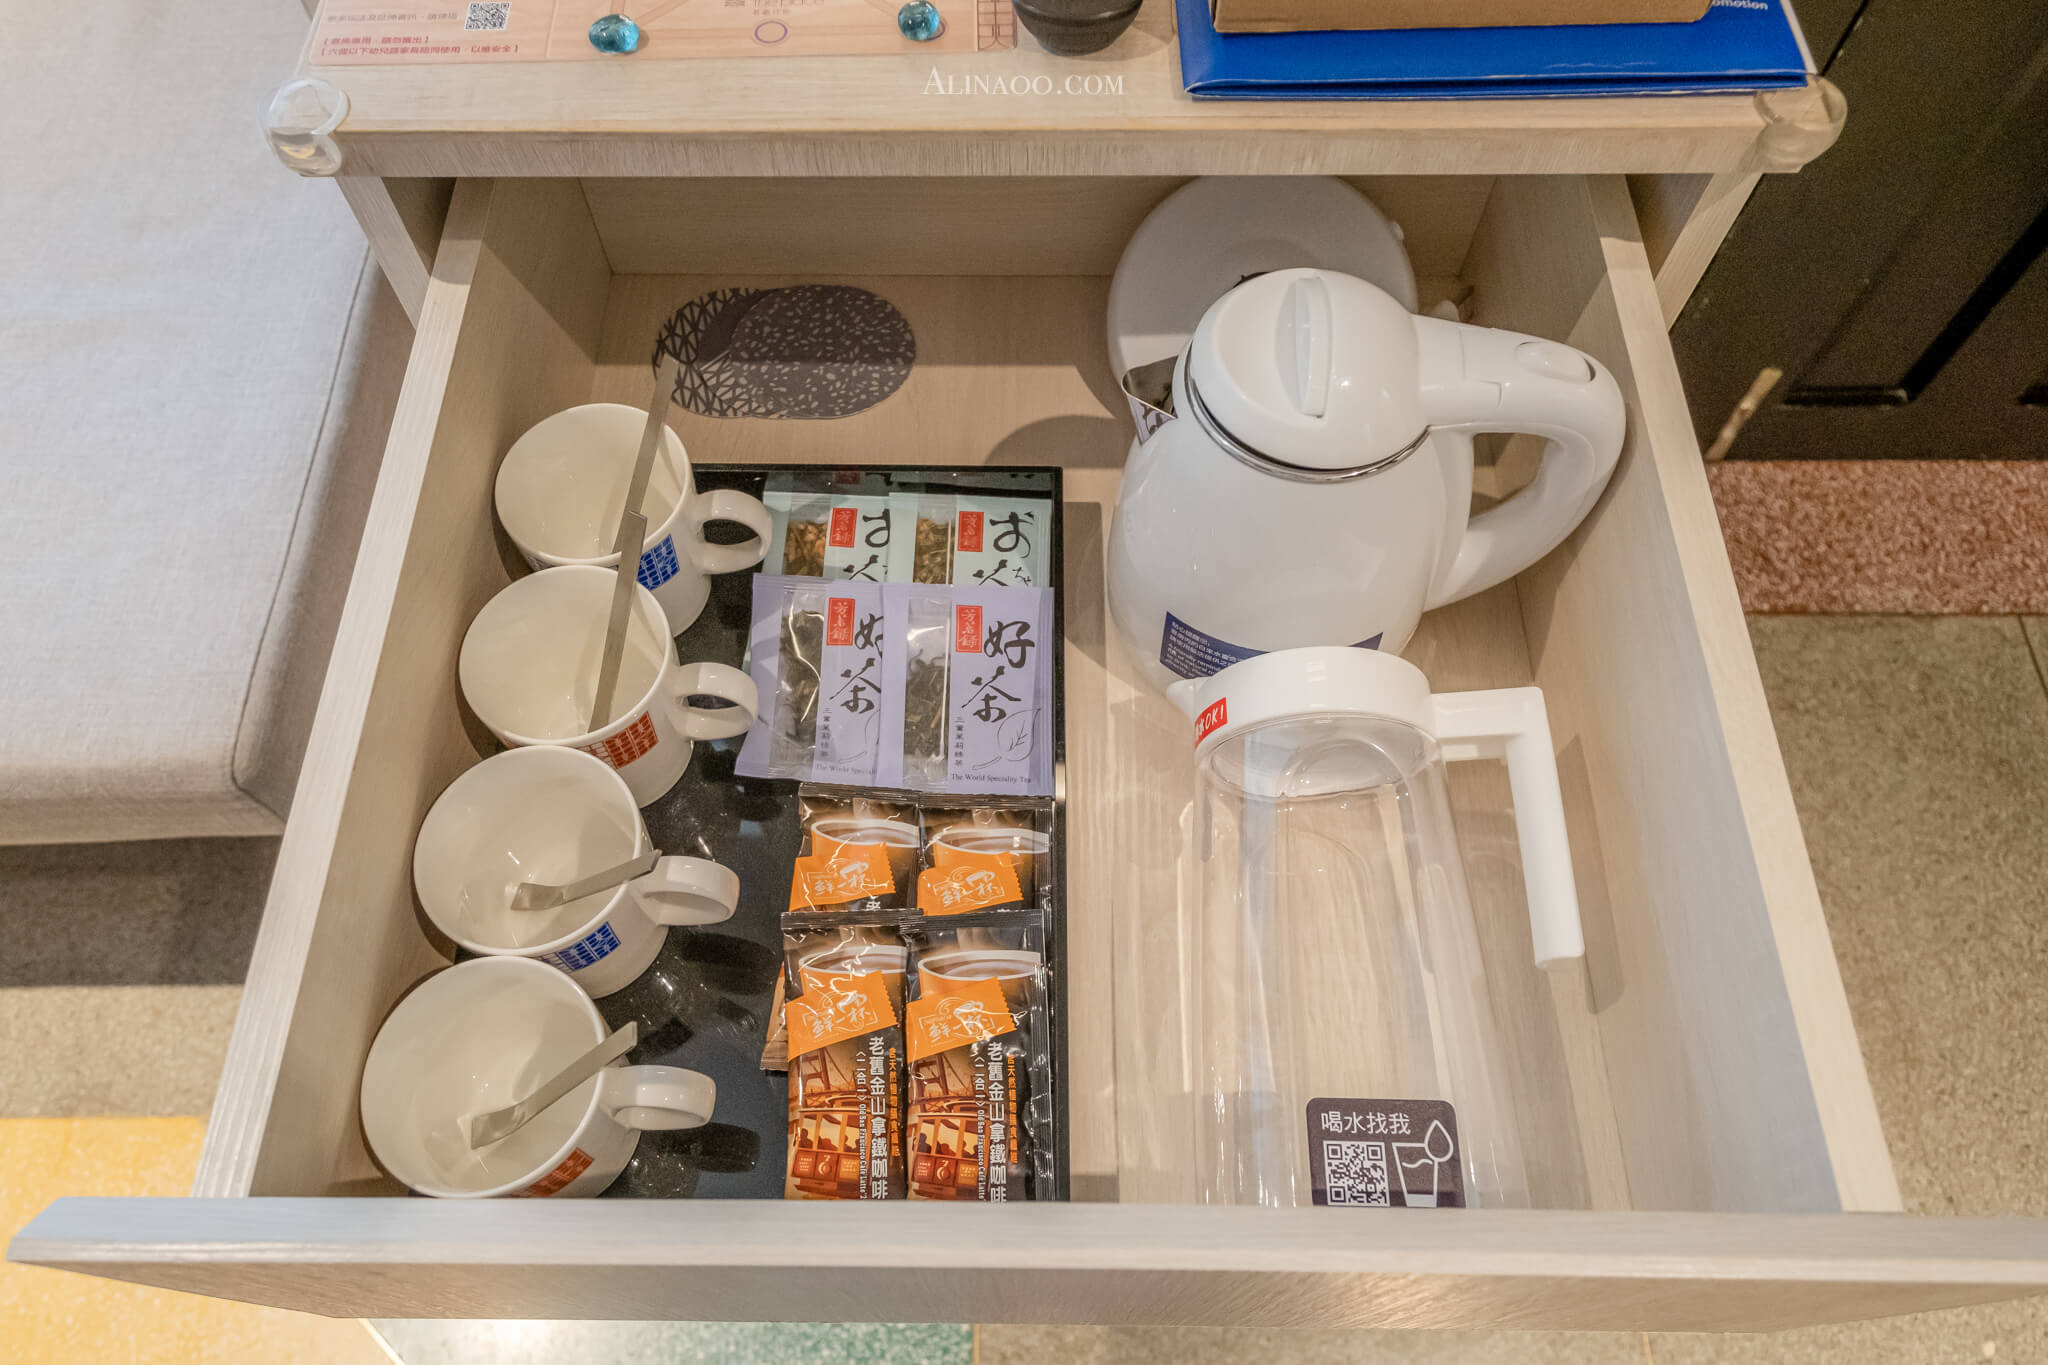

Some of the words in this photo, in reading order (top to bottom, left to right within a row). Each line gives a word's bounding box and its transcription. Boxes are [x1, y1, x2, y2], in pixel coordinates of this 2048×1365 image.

[961, 620, 1036, 723] 好茶
[952, 773, 963, 781] The
[965, 774, 985, 782] World
[859, 1103, 868, 1114] Old
[859, 1115, 868, 1127] San
[868, 1035, 889, 1200] 老舊金山拿鐵咖啡
[977, 1109, 986, 1121] Old
[977, 1121, 986, 1133] San
[987, 1041, 1008, 1202] 老舊金山拿鐵咖啡
[1321, 1111, 1411, 1135] 喝水找我
